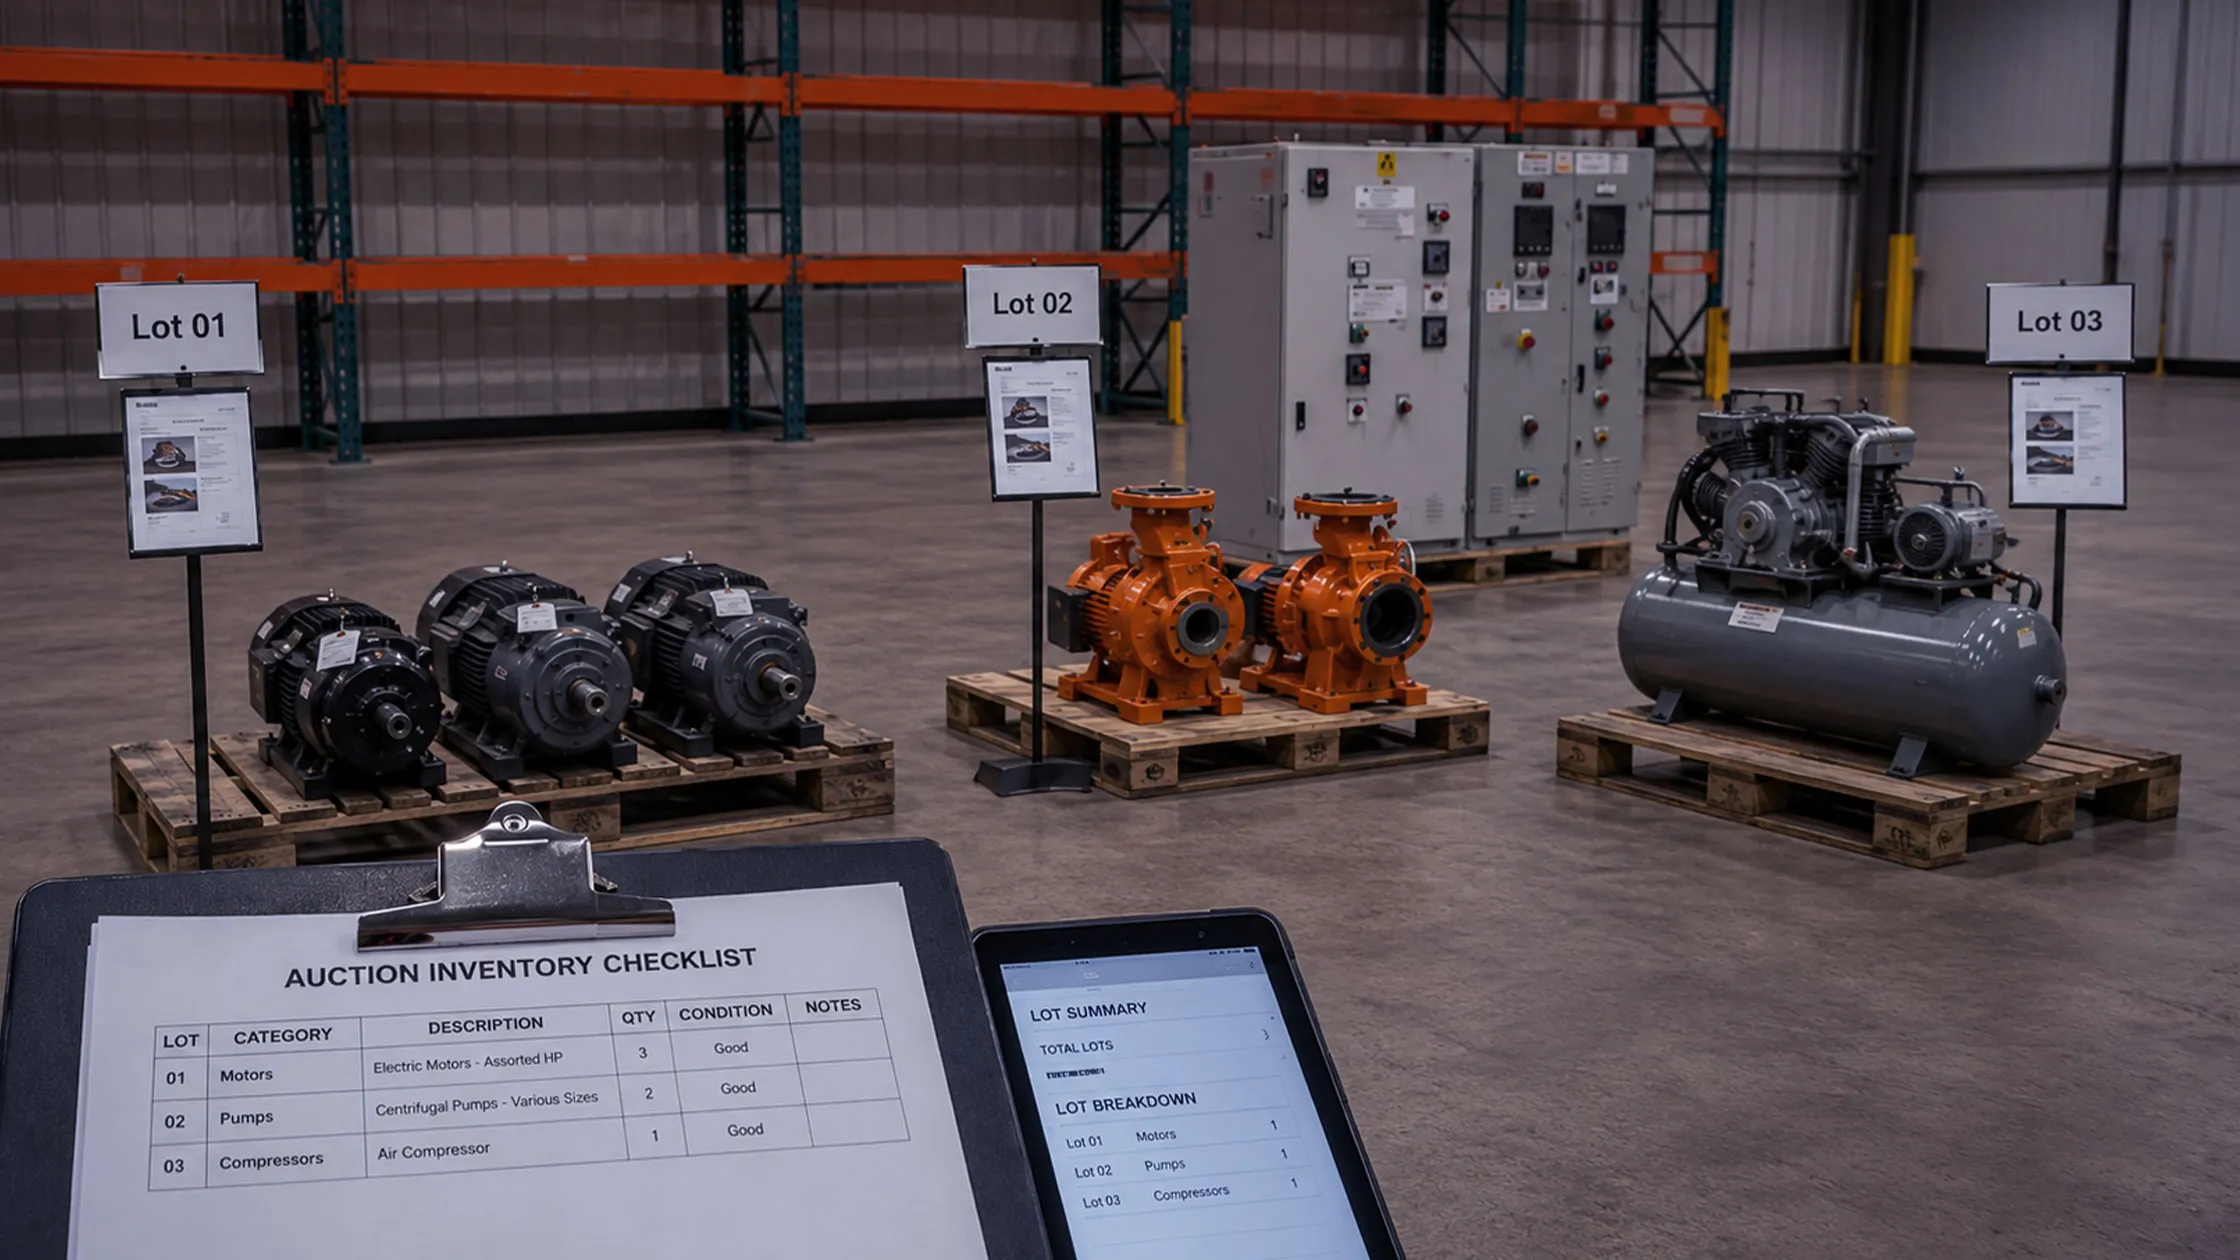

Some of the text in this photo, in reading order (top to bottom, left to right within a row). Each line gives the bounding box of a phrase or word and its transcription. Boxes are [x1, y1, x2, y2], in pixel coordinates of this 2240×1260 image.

[993, 291, 1073, 315] Lot 02
[132, 312, 225, 340] Lot 01
[2018, 309, 2103, 333] Lot 03
[284, 947, 757, 989] AUCTION INVENTORY CHECKLIST
[679, 1003, 773, 1021] CONDITION
[805, 998, 862, 1014] NOTES
[1030, 1001, 1147, 1023] LOT SUMMARY
[428, 1016, 544, 1035] DESCRIPTION
[621, 1010, 656, 1025] QTY
[163, 1033, 200, 1049] LOT
[233, 1027, 333, 1045] CATEGORY
[638, 1046, 648, 1059] 3
[713, 1041, 749, 1055] Good
[1039, 1039, 1114, 1055] TOTAL LOTS
[373, 1061, 423, 1074] Electric
[426, 1059, 472, 1071] Motors
[484, 1052, 540, 1068] Assorted
[543, 1051, 564, 1064] HP
[166, 1071, 185, 1085] 01
[220, 1069, 273, 1083] Motors
[644, 1087, 653, 1100] 2
[720, 1081, 757, 1095] Good
[375, 1100, 449, 1117] Centrifugal
[452, 1099, 498, 1113] Pumps
[510, 1094, 561, 1108] Various
[563, 1091, 599, 1105] Sizes
[1055, 1091, 1197, 1116] LOT BREAKDOWN
[164, 1114, 185, 1129] 02
[220, 1112, 274, 1126] Pumps
[727, 1122, 765, 1137] Good
[1135, 1130, 1177, 1142] Motors
[1066, 1135, 1103, 1149] Lot 01
[377, 1144, 491, 1160] Air Compressor
[163, 1158, 185, 1174] 03
[219, 1154, 324, 1171] Compressors
[1144, 1159, 1186, 1172] Pumps
[1074, 1164, 1113, 1179] Lot 02
[1082, 1194, 1121, 1209] Lot 03
[1153, 1186, 1230, 1202] Compressors
